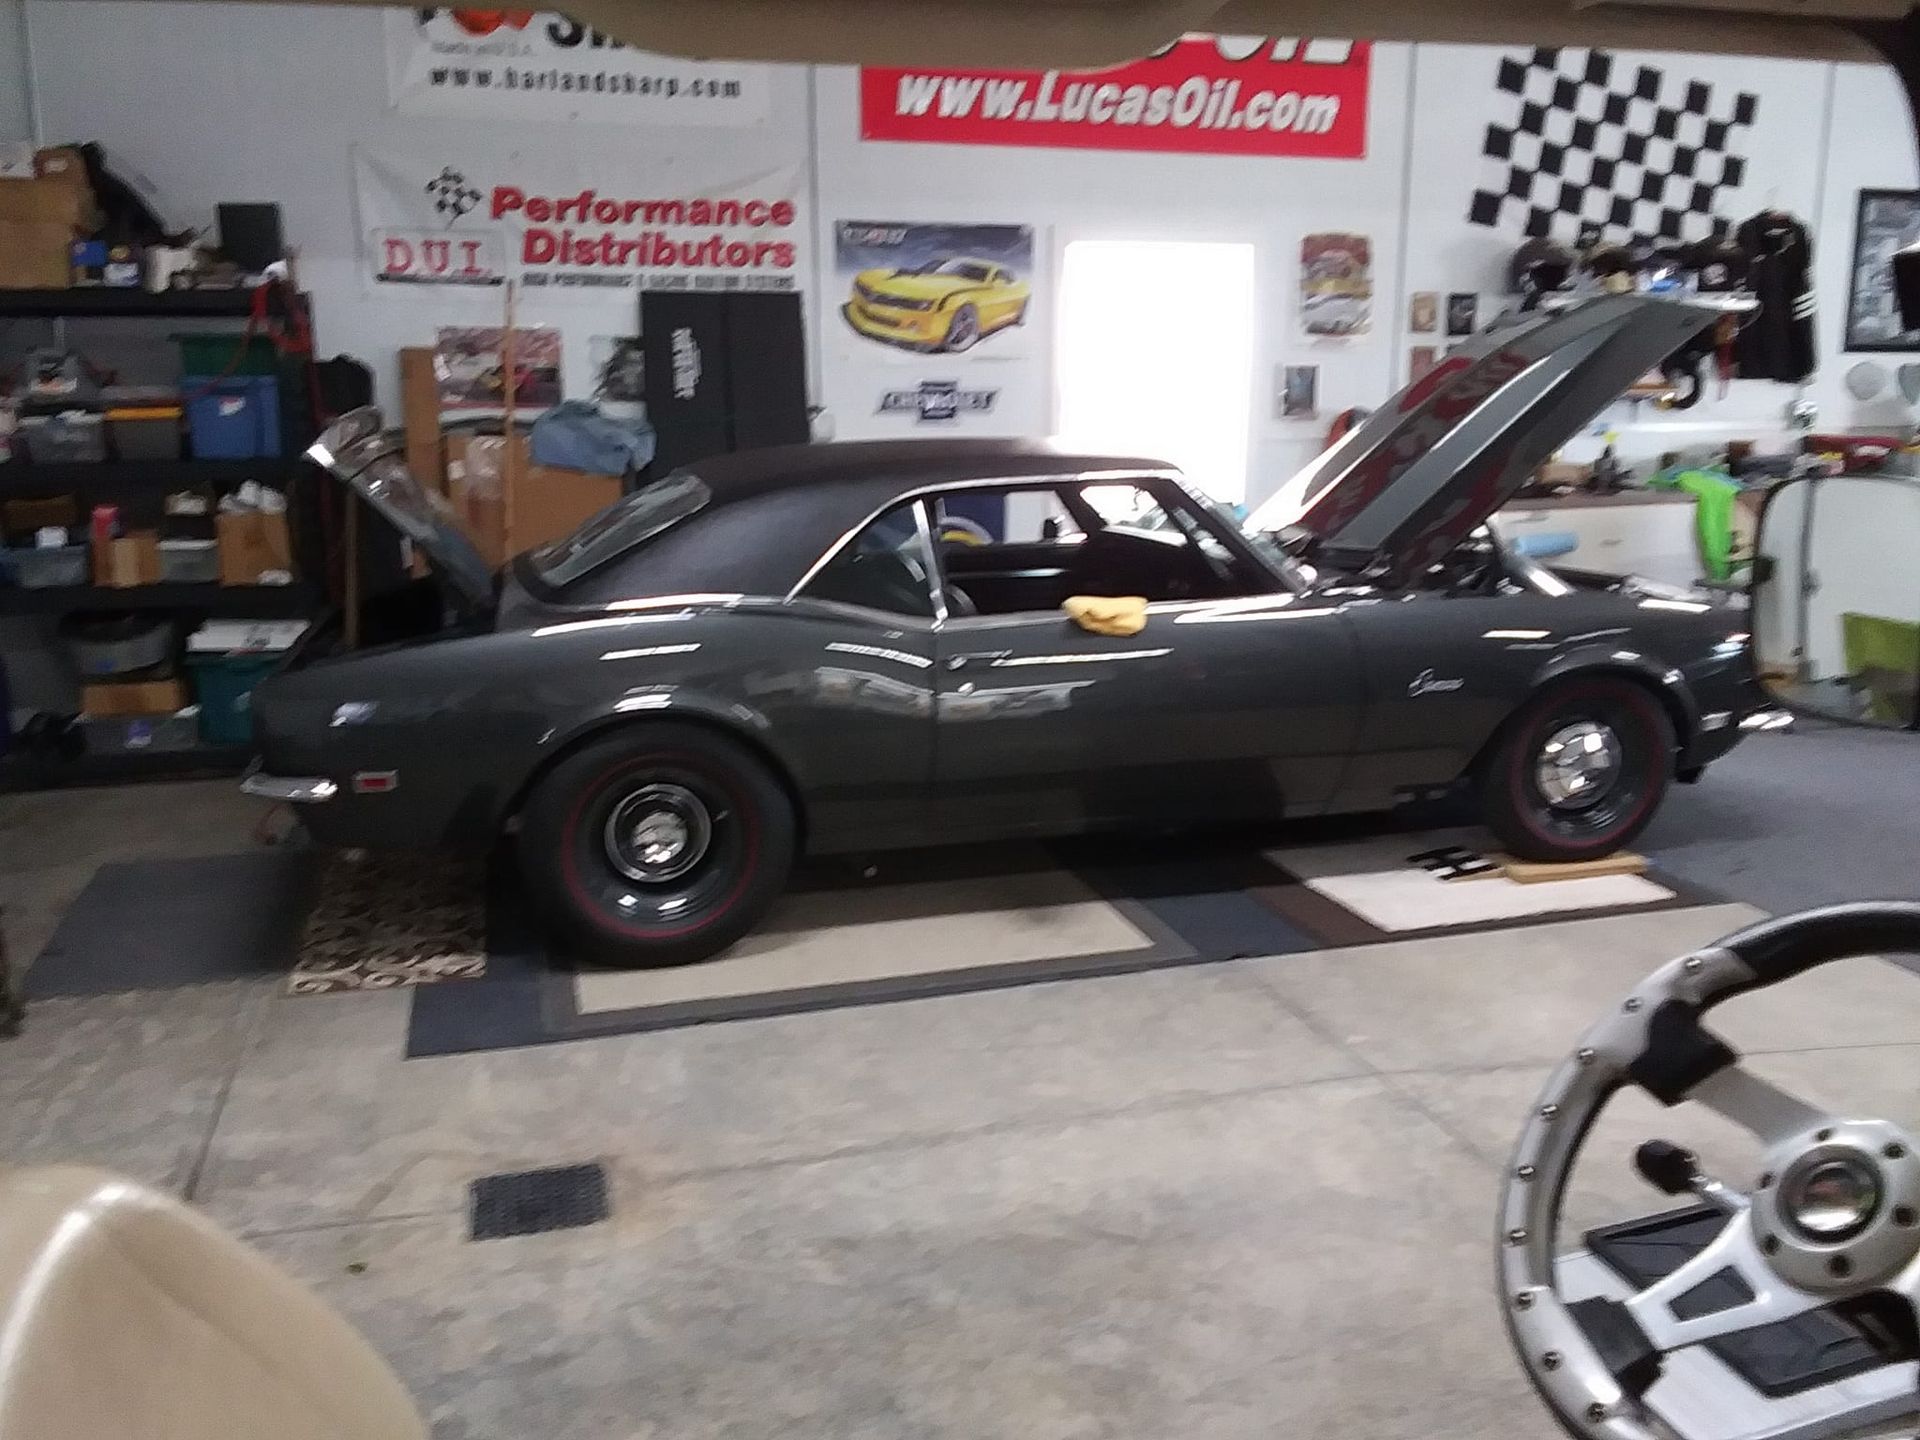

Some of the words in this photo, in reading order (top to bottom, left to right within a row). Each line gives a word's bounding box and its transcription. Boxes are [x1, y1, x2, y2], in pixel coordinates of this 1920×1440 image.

[895, 70, 1341, 134] www.LucasOil.com
[490, 186, 795, 226] Performance
[522, 228, 796, 268] Distributors
